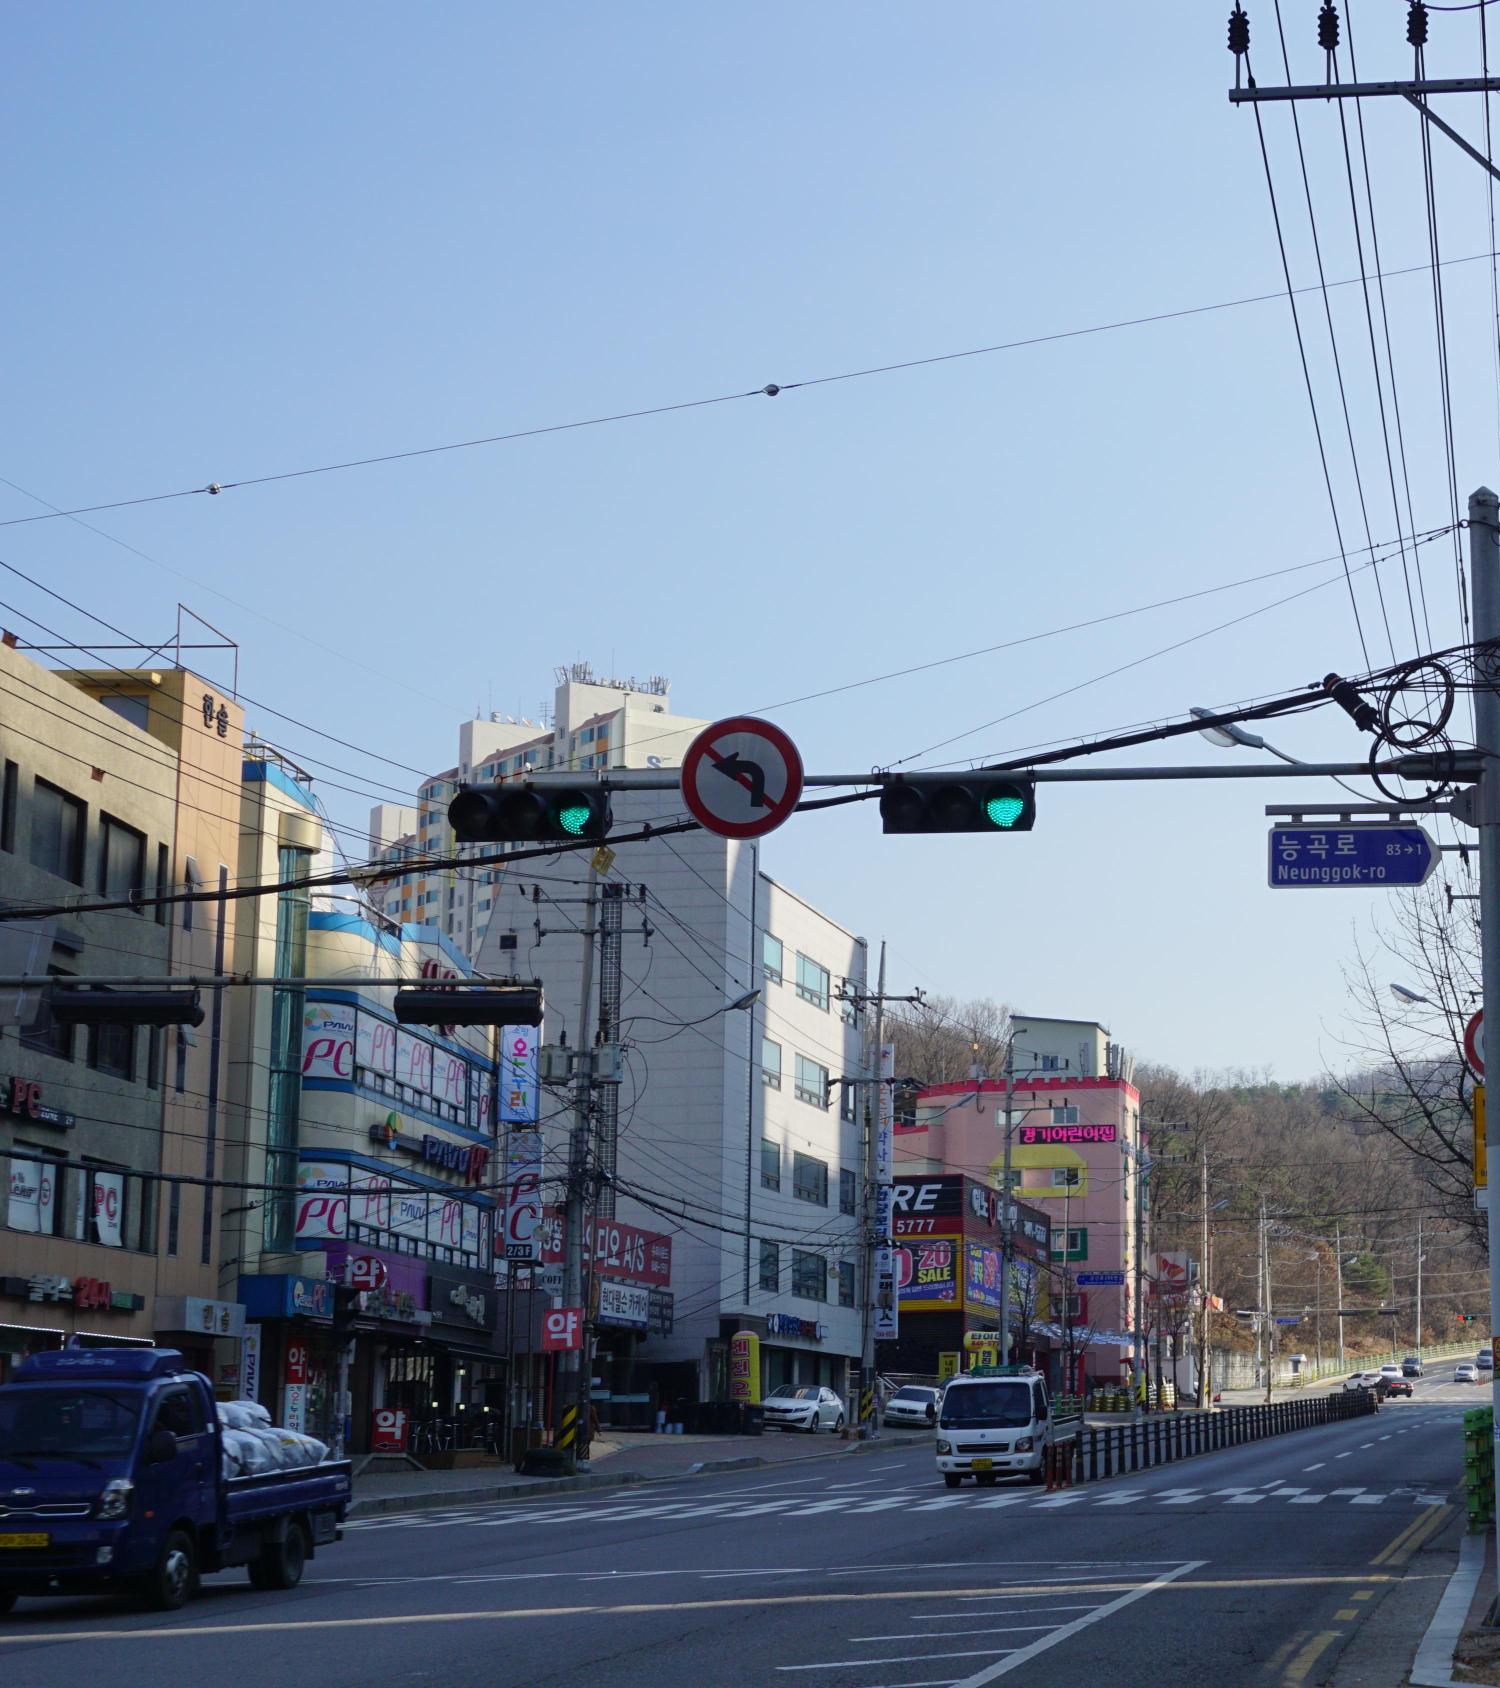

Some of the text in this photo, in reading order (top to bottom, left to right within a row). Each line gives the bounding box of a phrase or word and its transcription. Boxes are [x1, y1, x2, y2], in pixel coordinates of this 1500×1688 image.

[1278, 833, 1358, 861] 능곡로
[1385, 844, 1401, 856] 83
[1277, 864, 1386, 882] Neunggok-ro
[302, 1038, 353, 1077] PC
[1022, 1125, 1115, 1144] 경기어린이집
[295, 1197, 348, 1235] PC
[352, 1258, 380, 1288] 약
[917, 1267, 951, 1284] SALE
[547, 1311, 578, 1347] 약
[375, 1410, 408, 1441] 약
